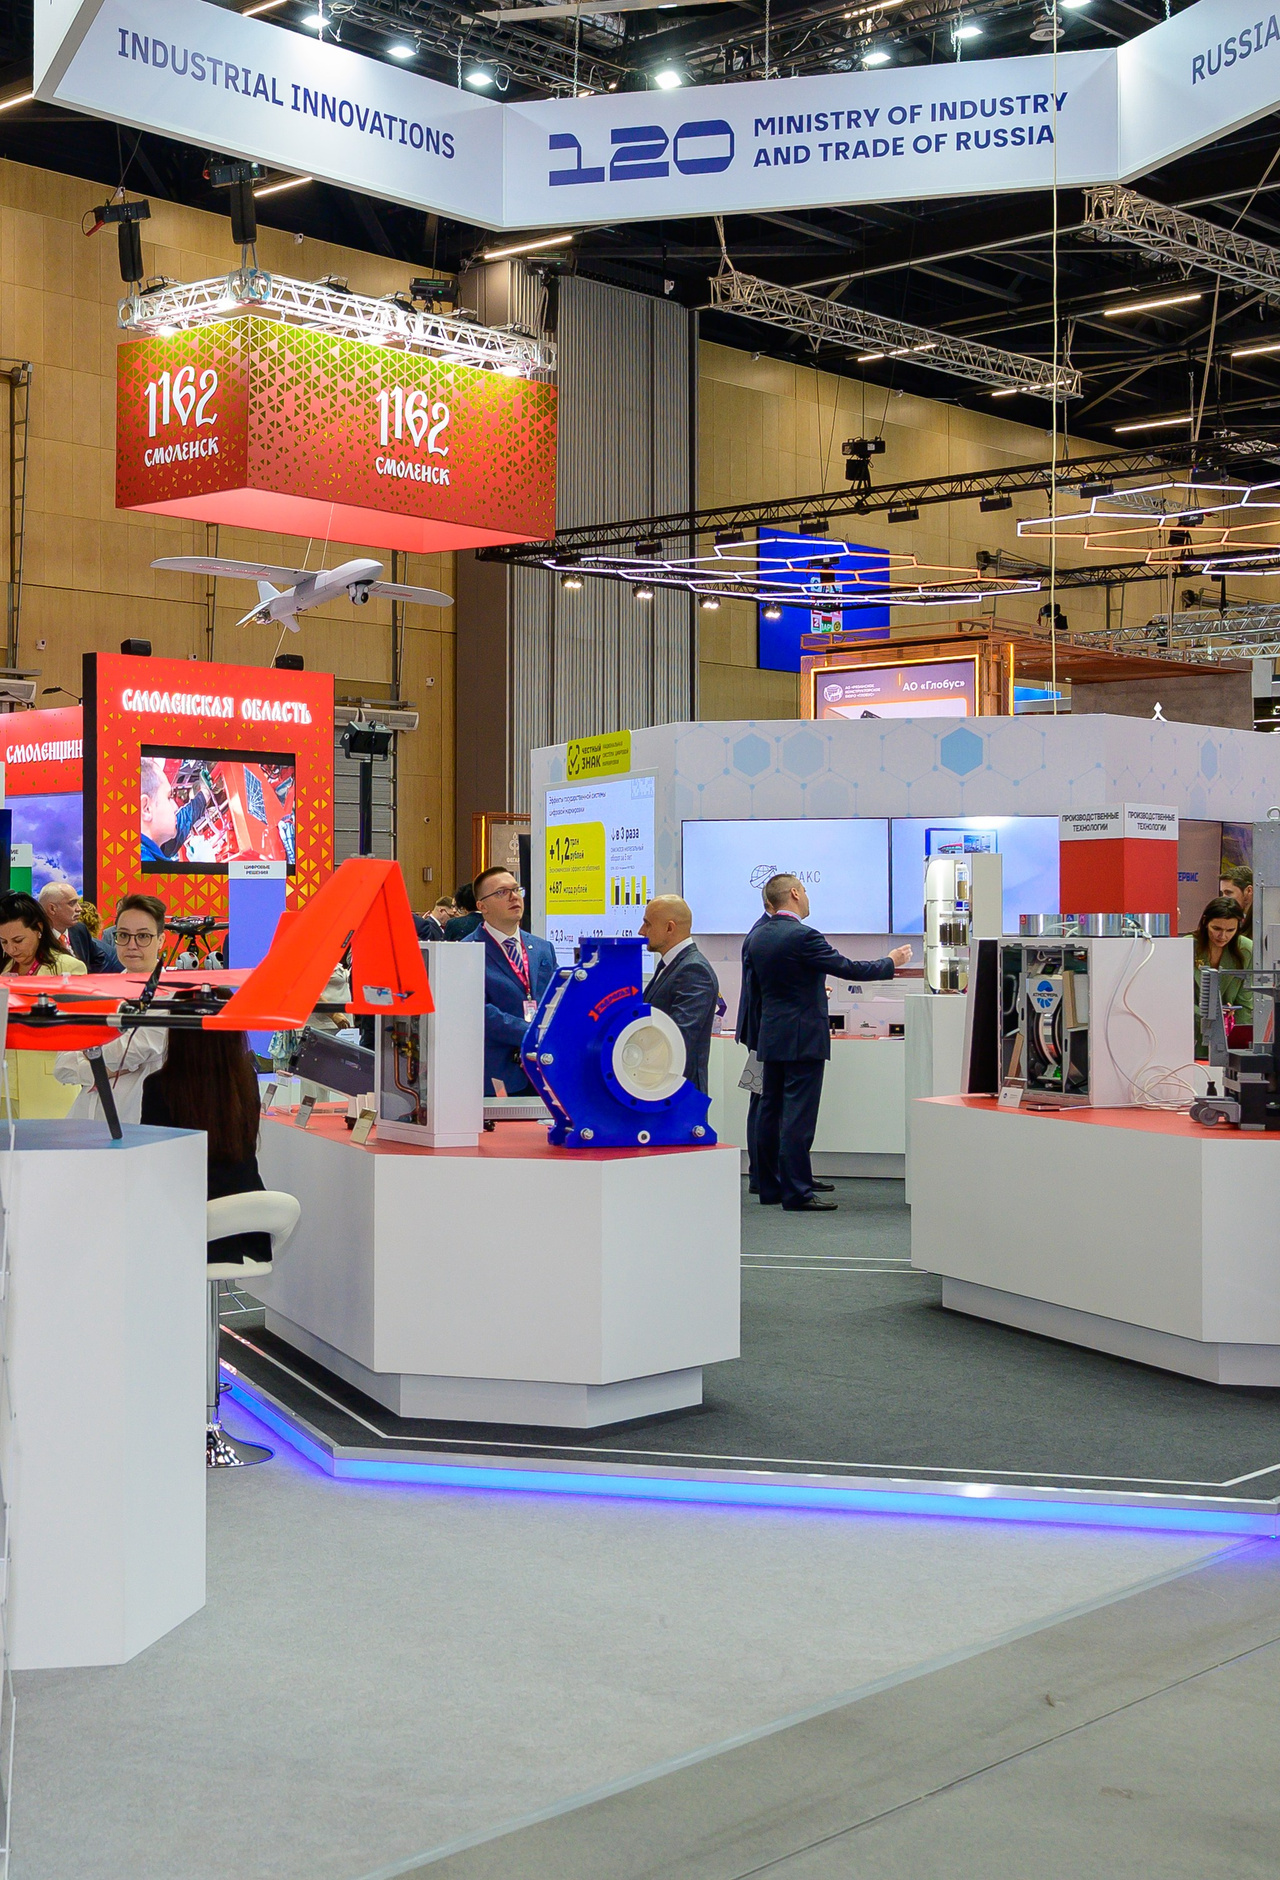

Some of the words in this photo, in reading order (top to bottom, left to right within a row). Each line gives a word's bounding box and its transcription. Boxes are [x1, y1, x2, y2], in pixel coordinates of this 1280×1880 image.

[117, 27, 284, 107] INDUSTRIAL
[291, 84, 455, 159] INNOVATIONS
[753, 107, 880, 138] MINISTRY
[891, 105, 922, 126] OF
[931, 91, 1068, 123] INDUSTRY
[753, 144, 811, 168] AND
[819, 135, 905, 162] TRADE
[912, 133, 947, 155] OF
[956, 124, 1055, 152] RUSSIA
[144, 436, 219, 467] СМОЛЕНСК
[375, 456, 450, 486] СМОЛЕНСК
[902, 681, 918, 692] АО
[920, 680, 965, 690] «Глобус»
[122, 688, 234, 718] СМОЛЕНСКАЯ
[241, 698, 312, 724] ОБЛАСТЬ
[582, 744, 601, 754] ЧЕСТНЫЙ
[582, 755, 601, 770] ЗНАК
[1062, 812, 1119, 822] ПРОИЗВОДСТВЕННЫЕ
[1128, 811, 1176, 821] ПРОИЗВОДСТВЕННЫЕ
[621, 826, 624, 840] 3
[626, 828, 639, 842] раза
[1073, 824, 1108, 832] ТЕХНОЛОГИИ
[1137, 823, 1166, 831] ТЕХНОЛОГИИ
